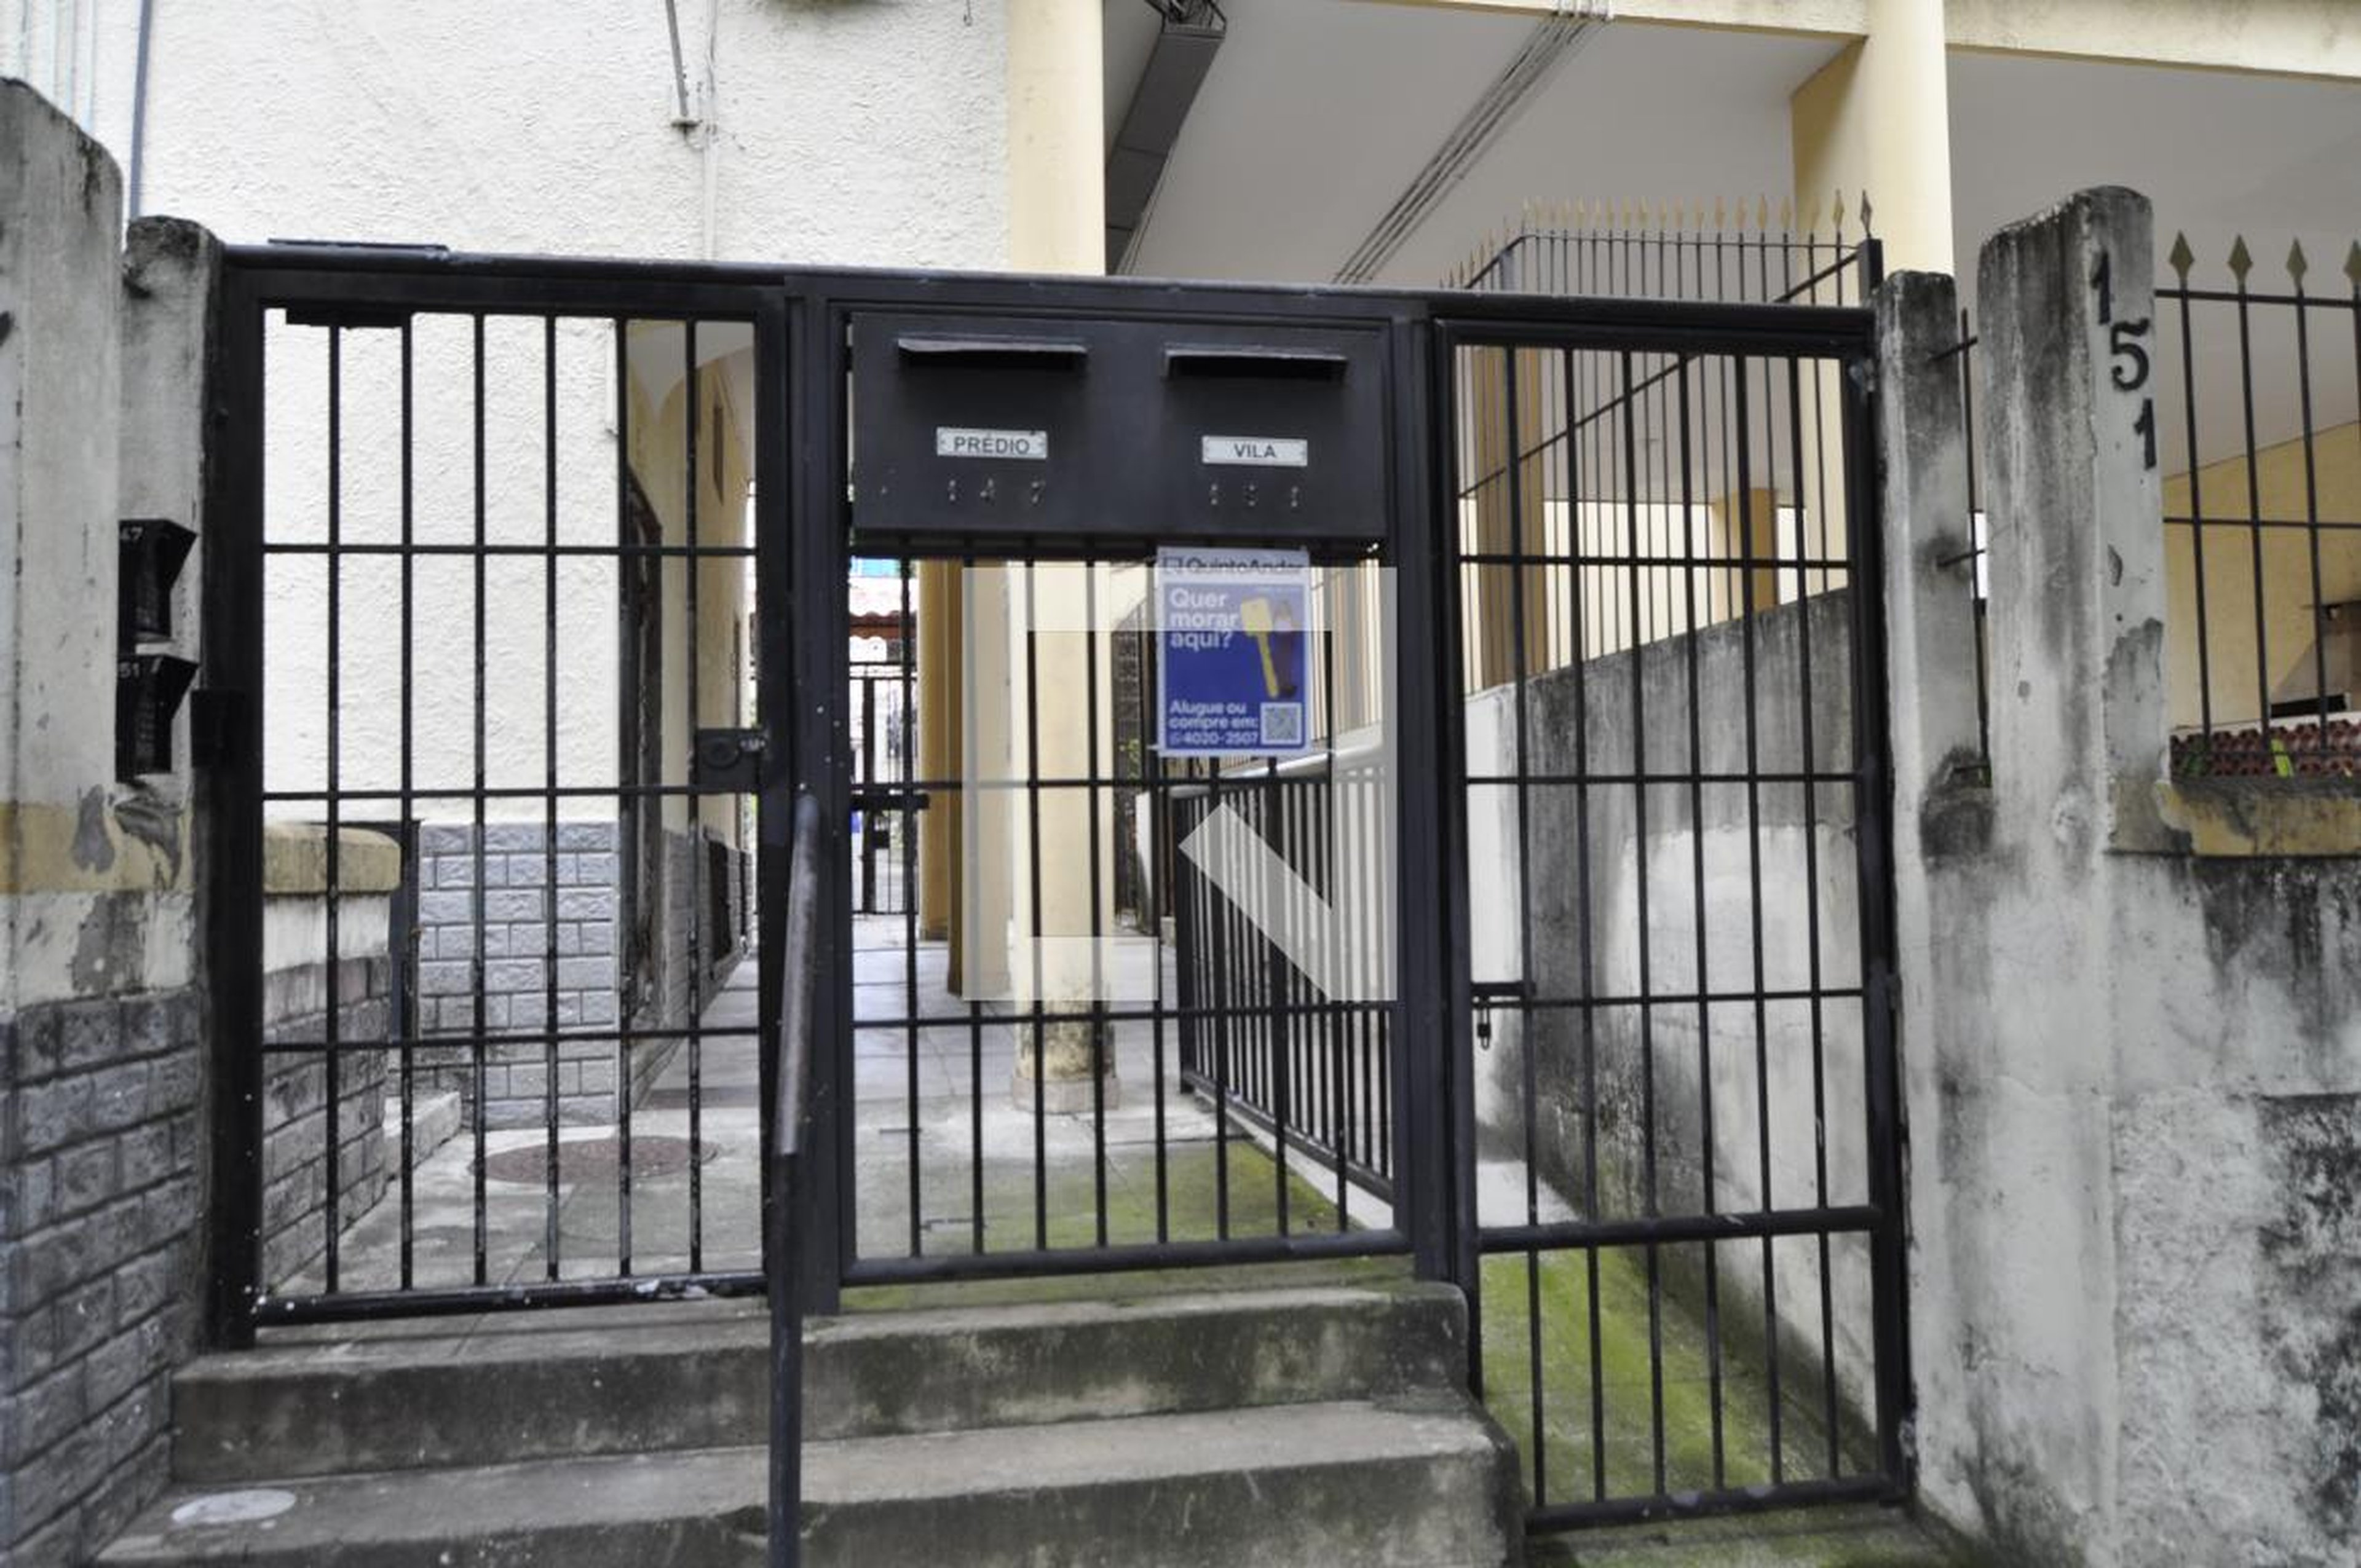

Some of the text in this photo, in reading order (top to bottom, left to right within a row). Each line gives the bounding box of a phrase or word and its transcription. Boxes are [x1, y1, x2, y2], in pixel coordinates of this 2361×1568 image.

[2090, 251, 2156, 471] 151
[954, 430, 1031, 455] PRÉDIO
[1234, 443, 1276, 459] VILA
[1171, 588, 1227, 609] Quer
[1170, 612, 1239, 628] morar
[1170, 628, 1232, 652] aqui?
[1169, 700, 1247, 715] Alugue ou
[1169, 717, 1228, 730] compre
